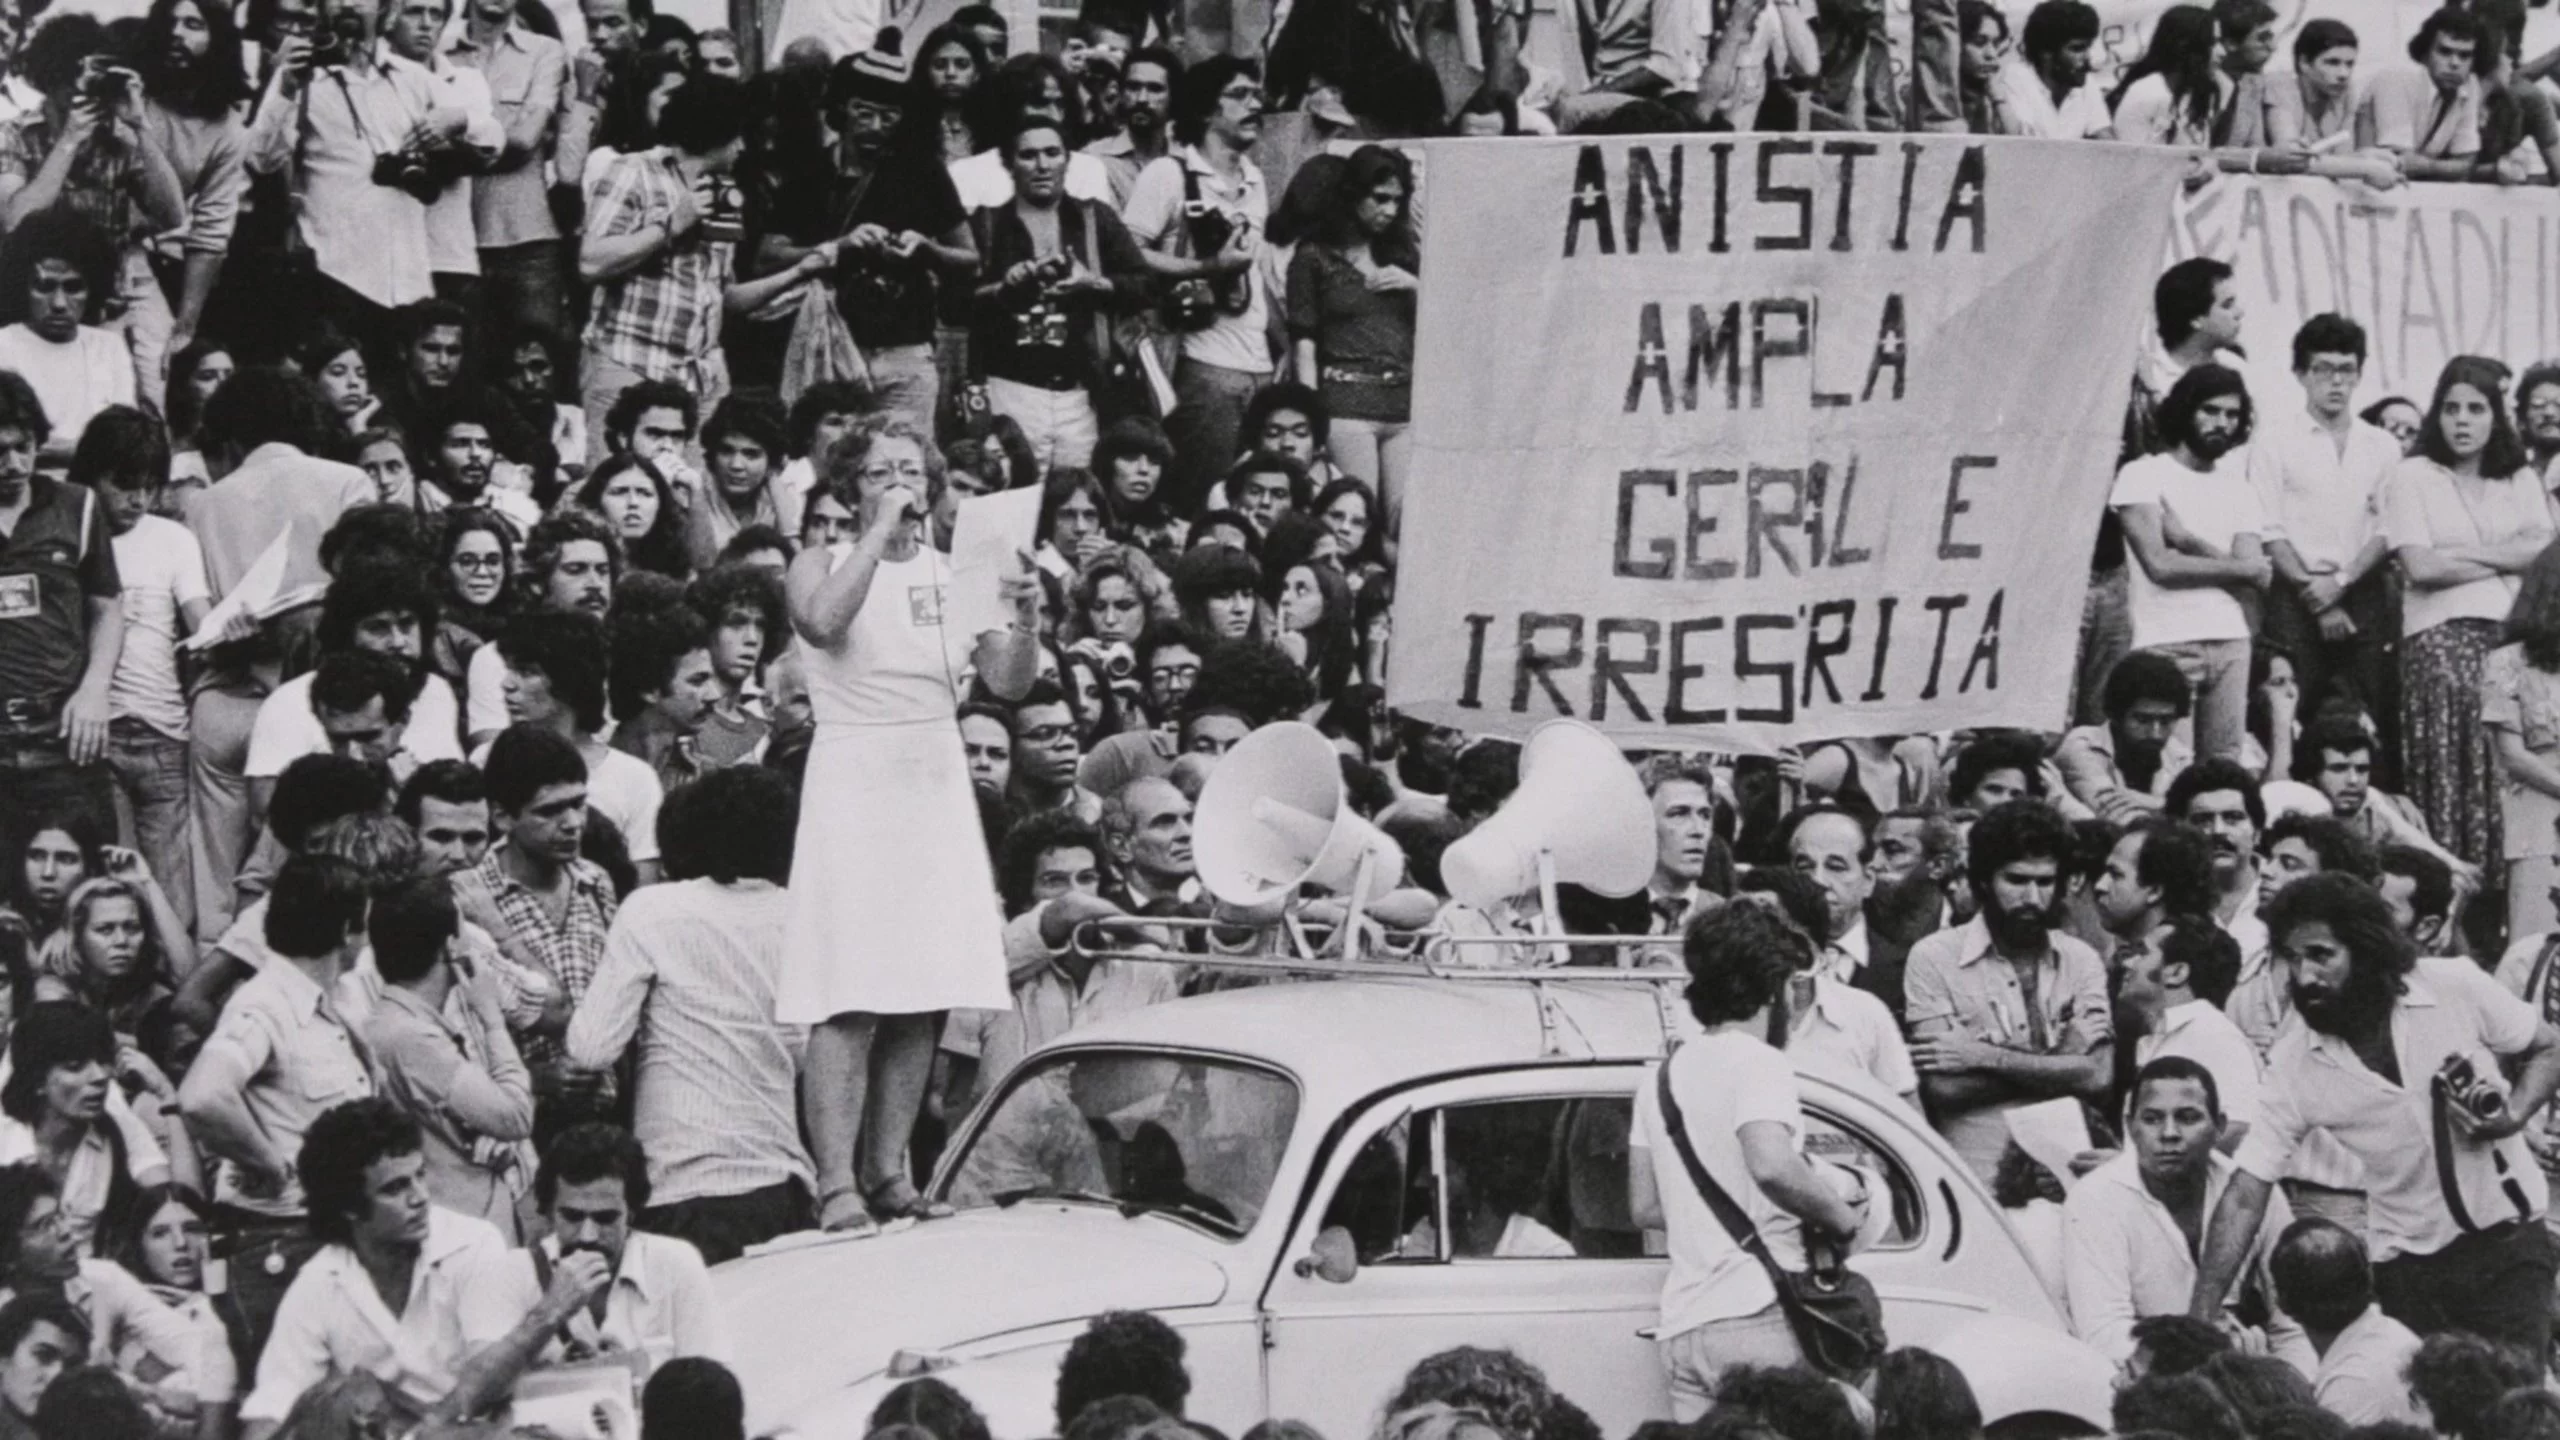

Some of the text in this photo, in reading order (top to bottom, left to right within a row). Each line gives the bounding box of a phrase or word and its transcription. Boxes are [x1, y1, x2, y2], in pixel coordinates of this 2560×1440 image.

[1562, 140, 1987, 257] ANISTIA
[1622, 292, 1907, 414] AMPLA
[1613, 454, 1999, 580] GERAL E
[1456, 586, 2005, 725] IRRESRITA
